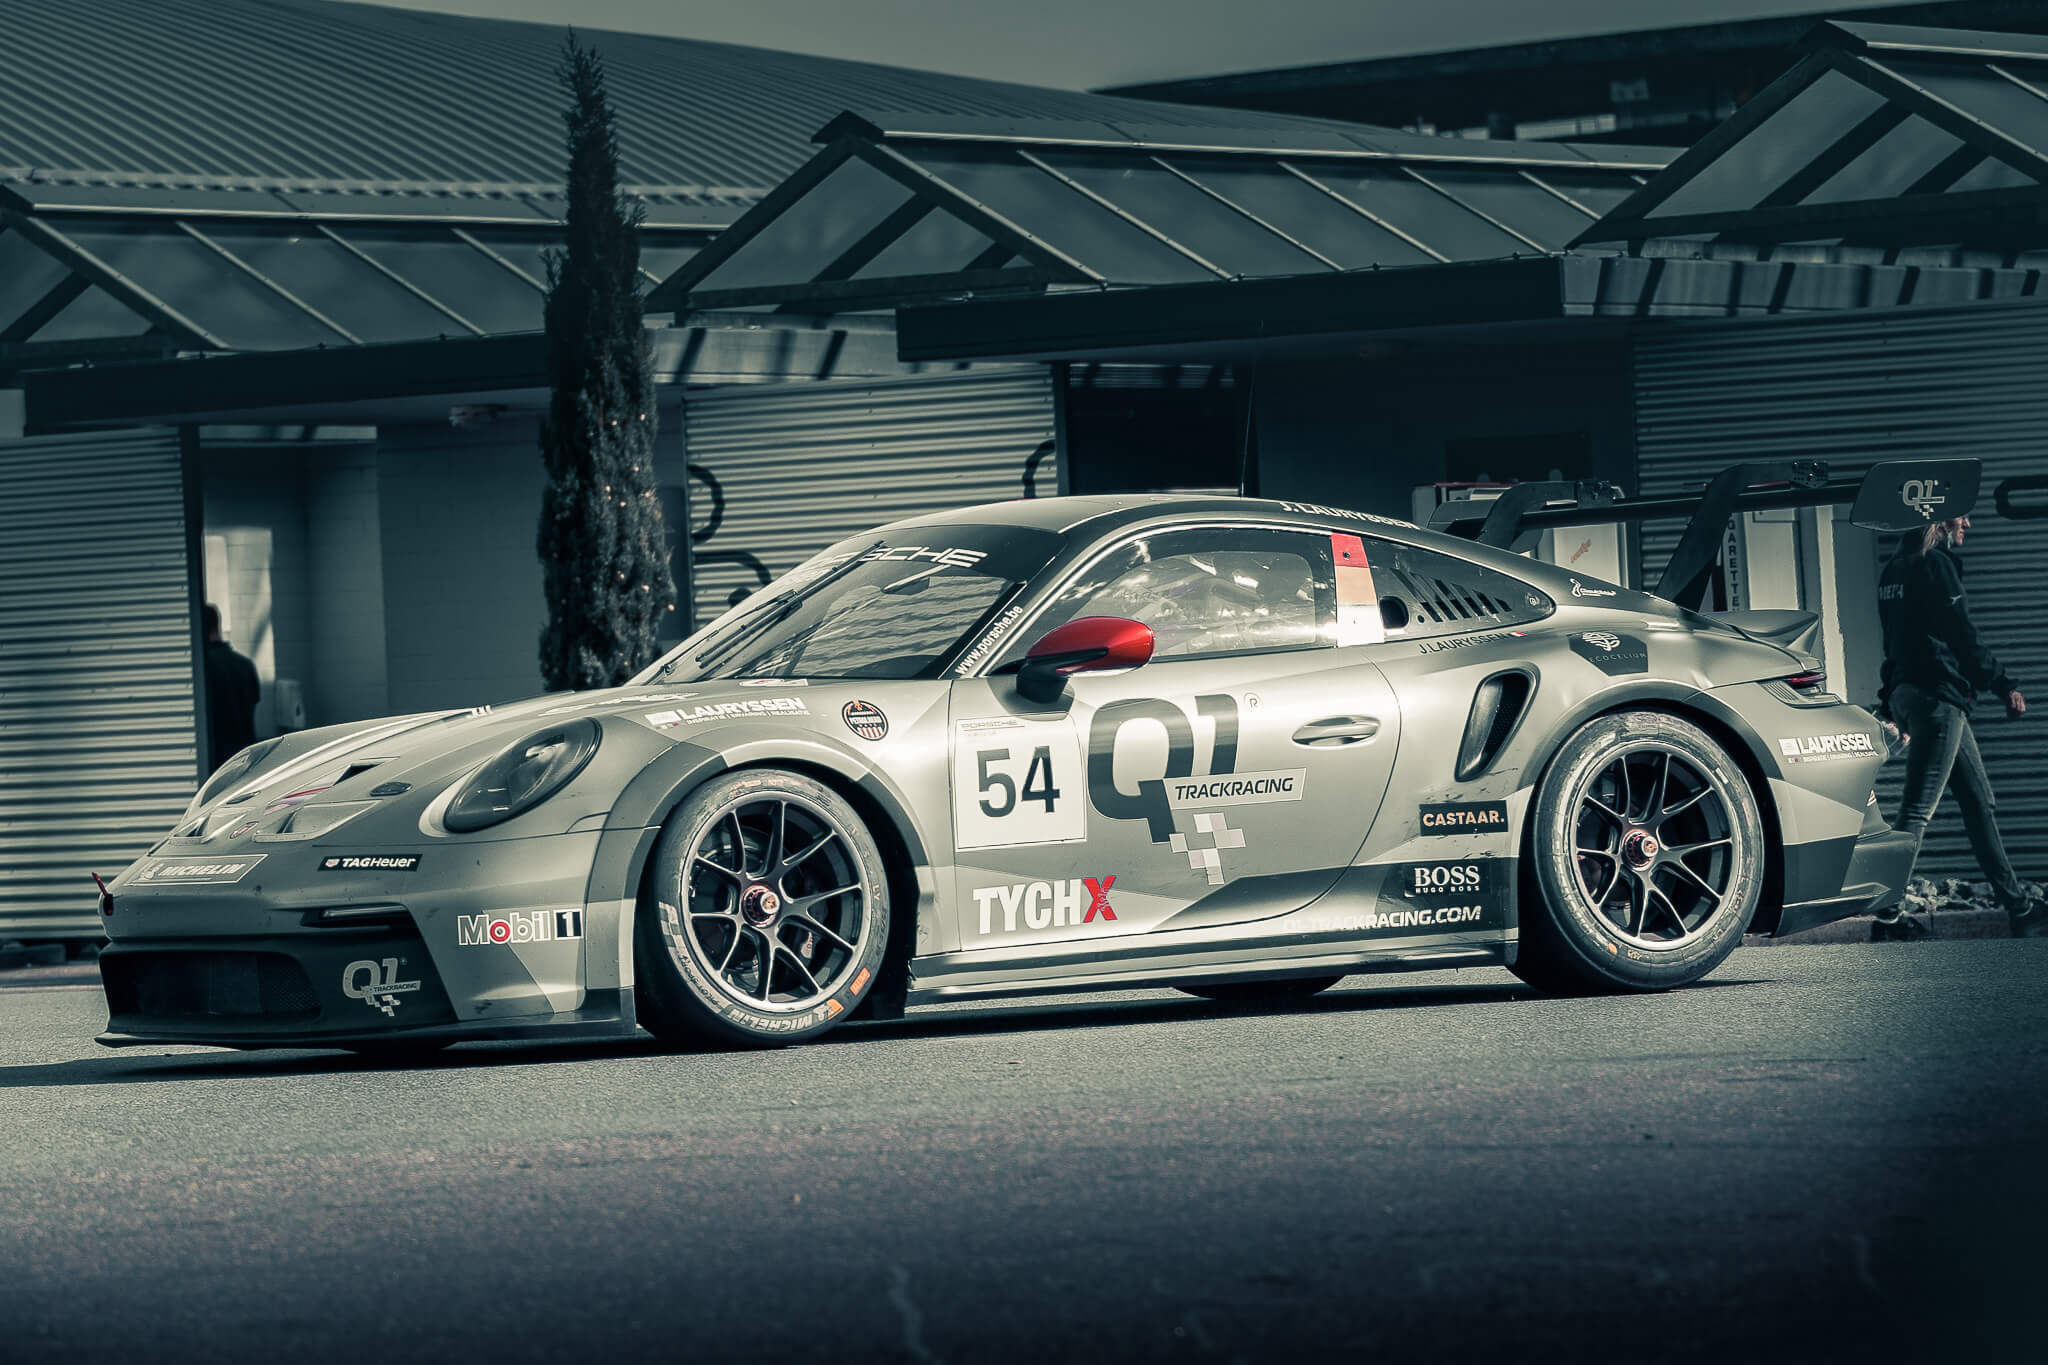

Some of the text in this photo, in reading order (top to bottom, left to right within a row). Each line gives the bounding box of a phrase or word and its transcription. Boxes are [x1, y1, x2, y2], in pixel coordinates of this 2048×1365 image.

[852, 545, 988, 568] SCHE
[954, 604, 1024, 675] www.porsche.be
[676, 696, 807, 720] LAURYSSEN
[1797, 733, 1874, 755] LAURYSSEN
[1087, 693, 1240, 845] Q1
[976, 745, 1061, 818] 54
[1173, 776, 1294, 802] TRACKRACING
[1422, 809, 1505, 828] CASTAAR.
[158, 863, 247, 877] MICHELIN
[1414, 865, 1481, 887] BOSS
[1450, 885, 1480, 893] BOSS
[972, 874, 1118, 935] TYCHX
[726, 1008, 813, 1033] MICHELIN
